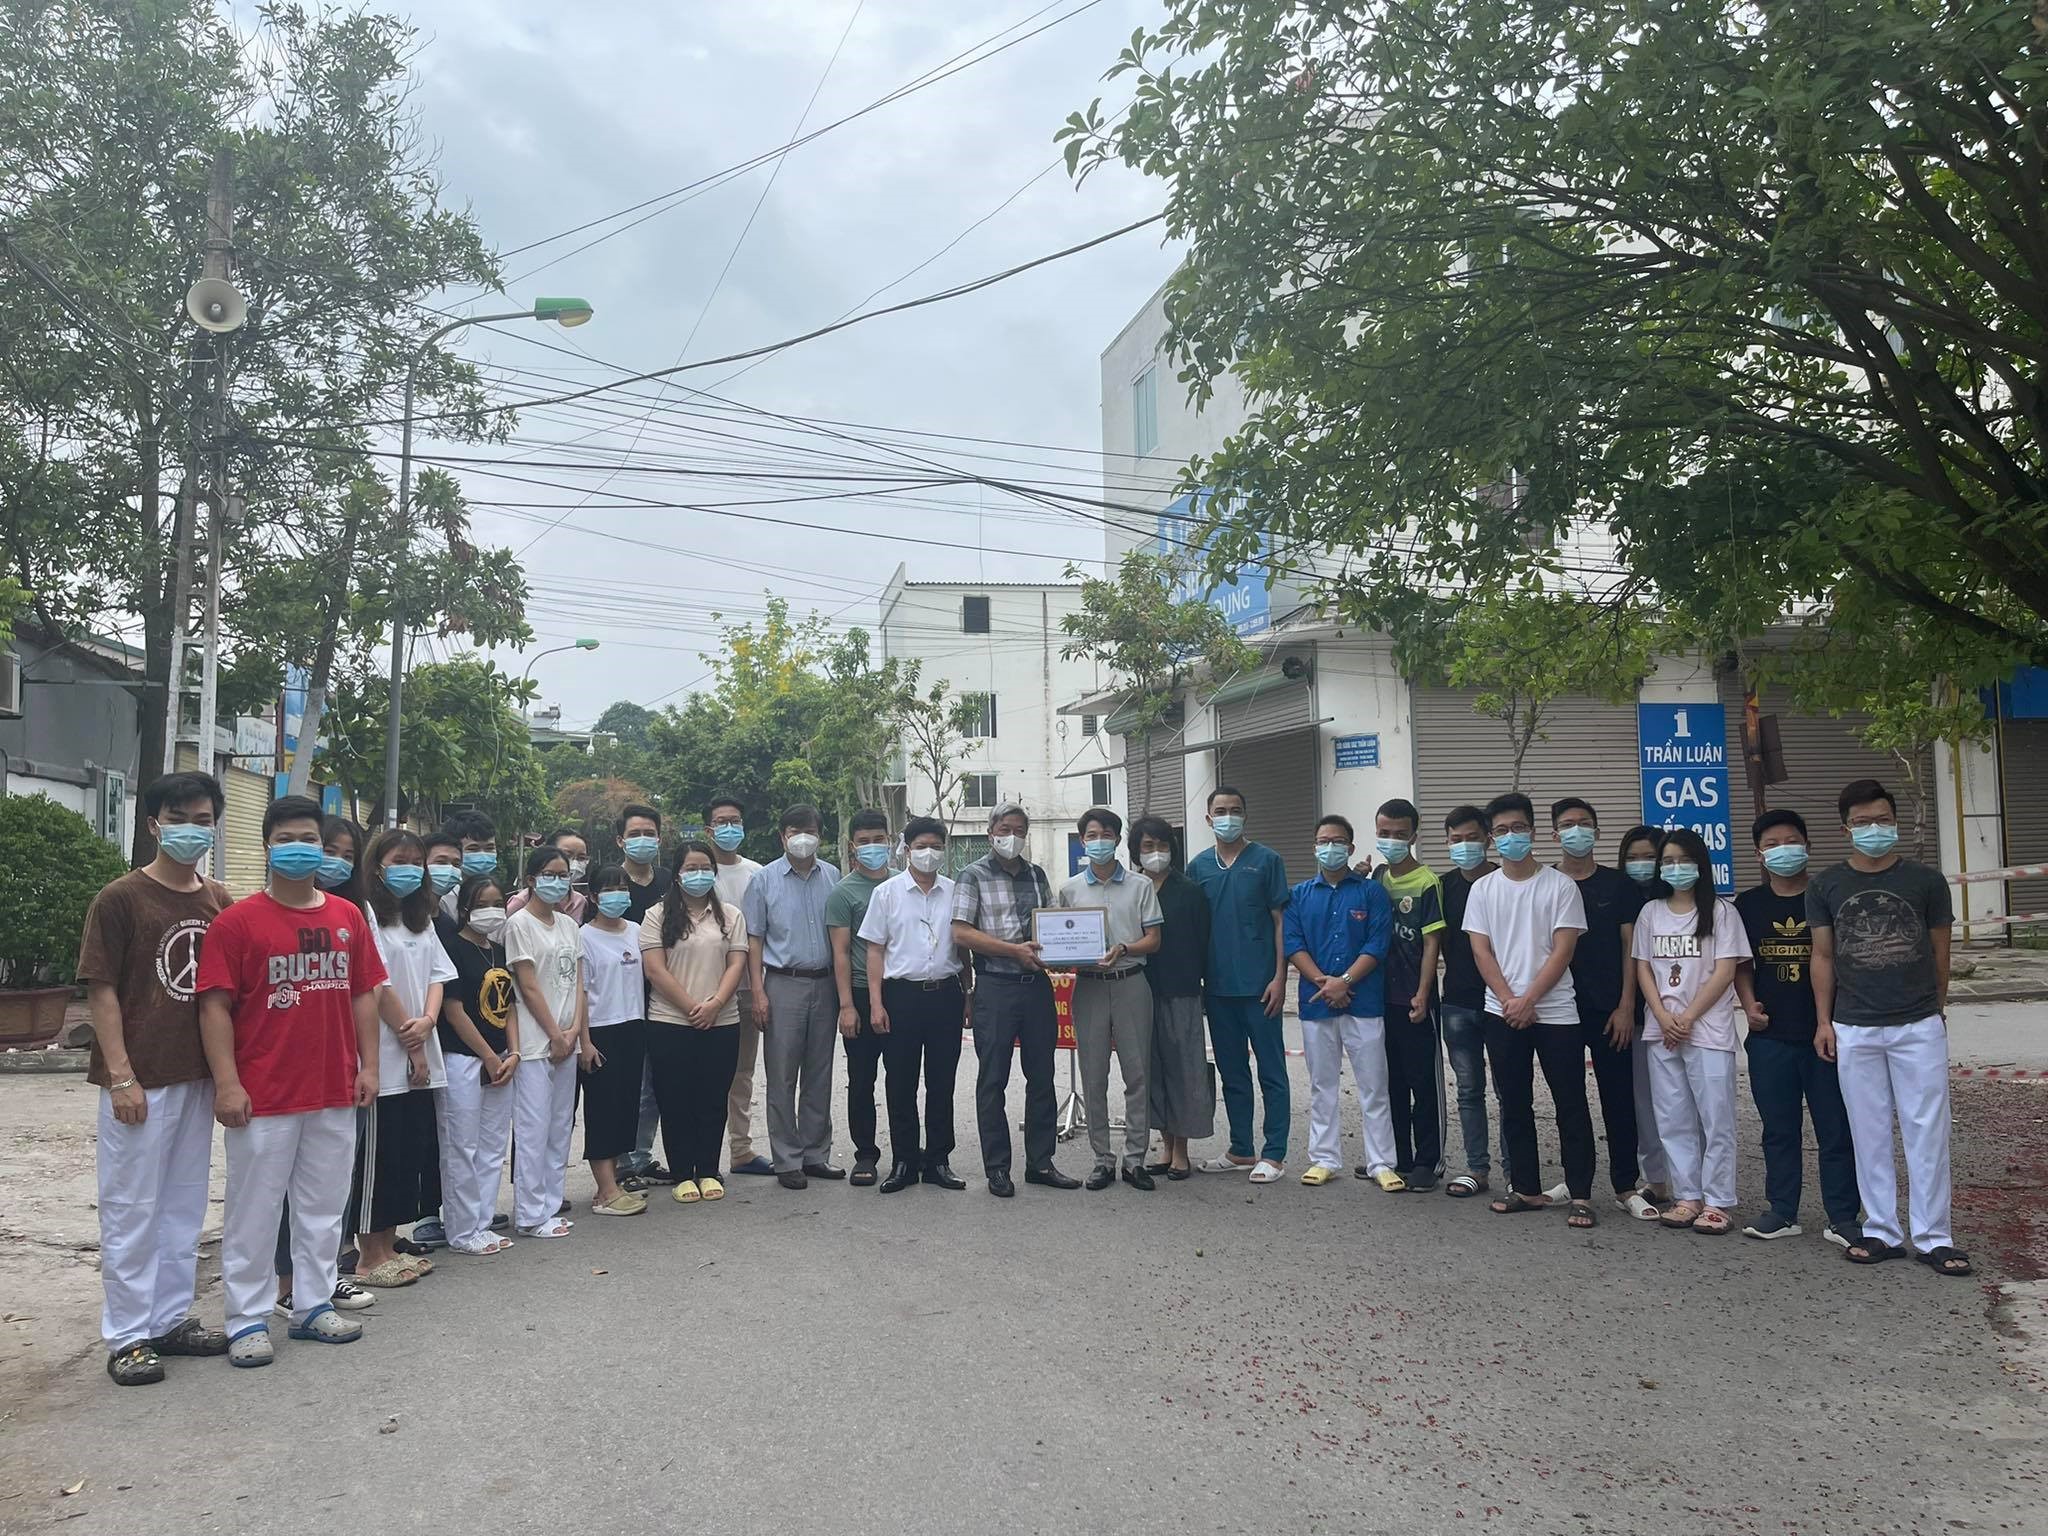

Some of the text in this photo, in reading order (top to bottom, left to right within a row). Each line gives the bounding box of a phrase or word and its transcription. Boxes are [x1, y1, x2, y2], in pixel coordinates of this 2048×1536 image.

[1674, 708, 1691, 738] 1
[1645, 738, 1723, 766] TRẦN LUẬN
[1655, 776, 1719, 808] GAS
[297, 927, 332, 953] GO
[1652, 935, 1701, 957] MARVEL
[1760, 945, 1810, 955] ORIGINA
[268, 950, 350, 985] BUCKS
[1776, 963, 1801, 982] 03
[281, 988, 301, 1006] STATE
